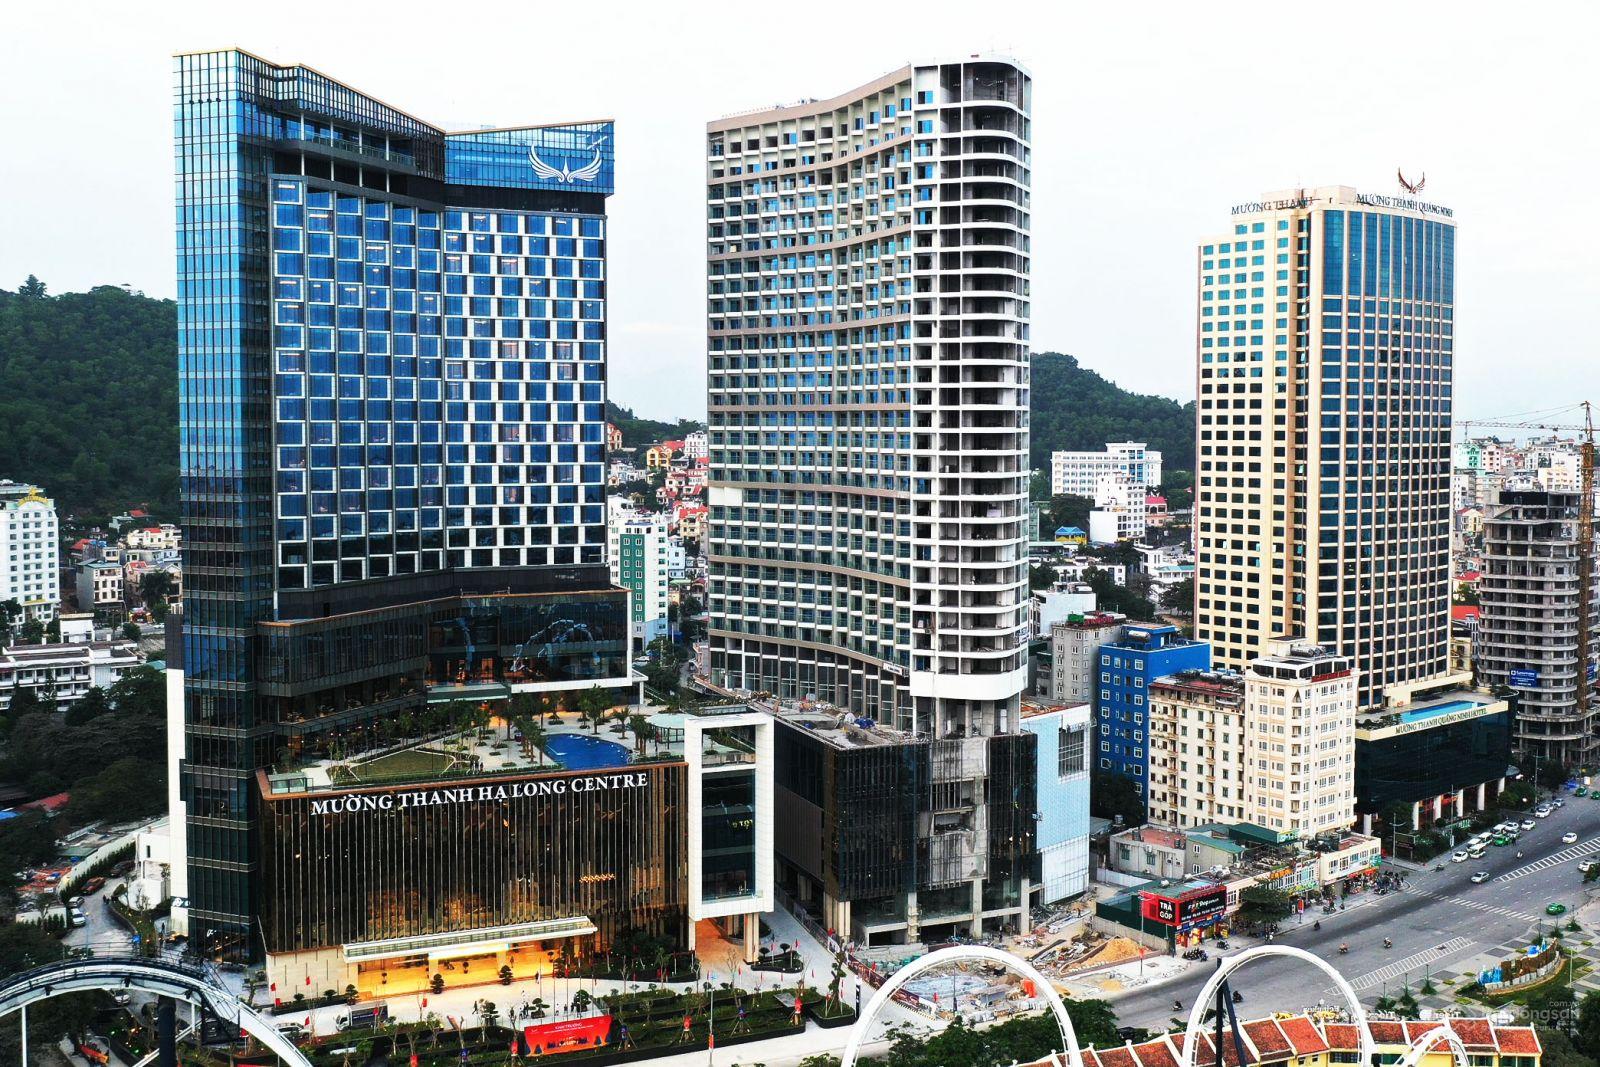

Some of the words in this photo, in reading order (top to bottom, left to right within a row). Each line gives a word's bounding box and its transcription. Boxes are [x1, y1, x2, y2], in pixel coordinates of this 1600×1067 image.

[1391, 197, 1418, 211] THANH
[1418, 718, 1438, 730] THANH
[1457, 711, 1471, 721] NINH
[1471, 708, 1488, 718] HOTEL
[311, 794, 393, 816] MƯỜNG
[397, 788, 473, 808] THANH
[478, 785, 508, 802] HẠ
[512, 780, 566, 798] LONG
[571, 772, 648, 793] CENTRE
[1160, 911, 1173, 920] GÓP
